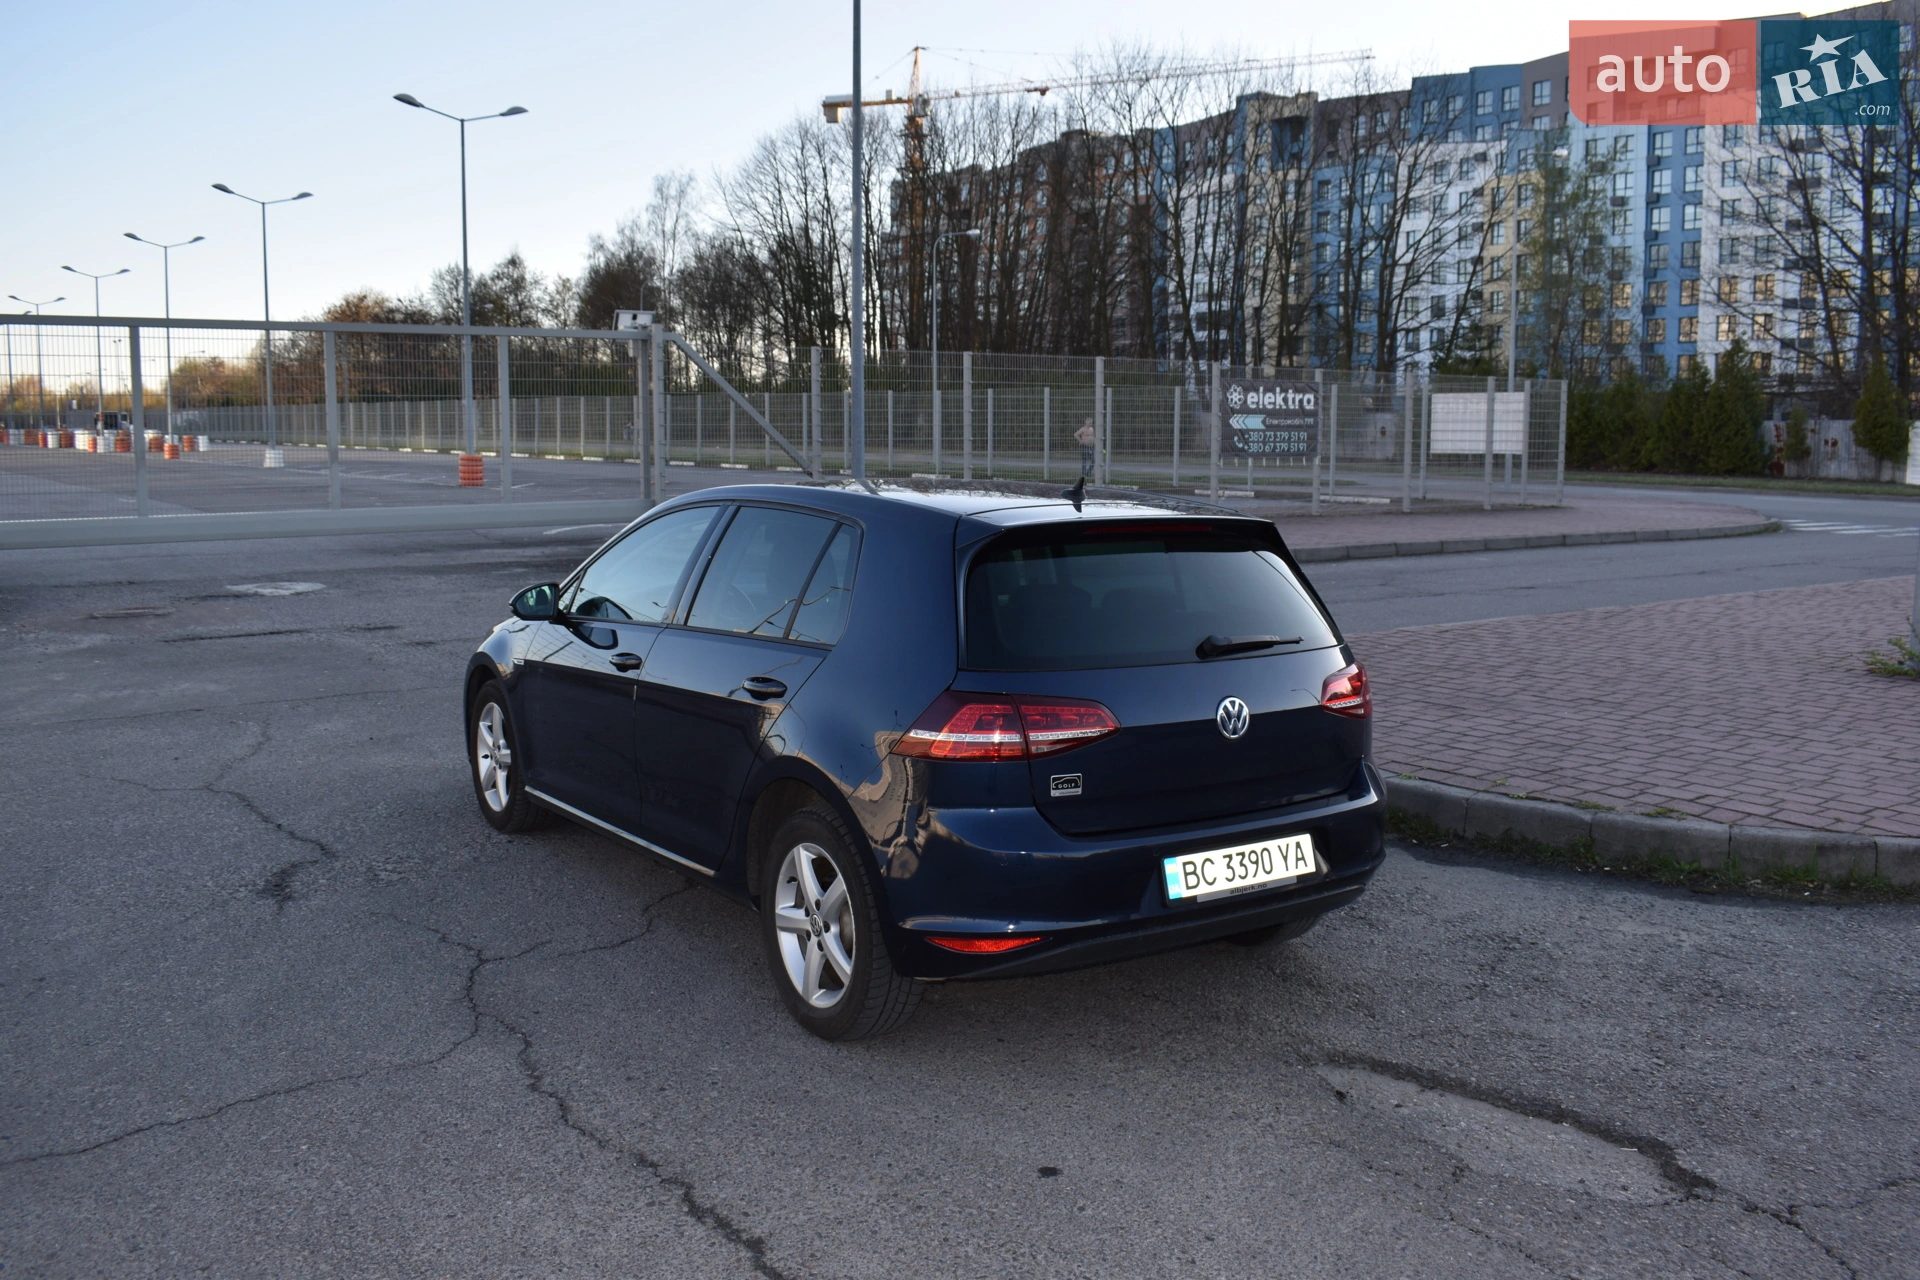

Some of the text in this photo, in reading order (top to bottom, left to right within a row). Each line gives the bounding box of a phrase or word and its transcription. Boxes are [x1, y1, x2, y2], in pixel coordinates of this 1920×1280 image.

[1247, 386, 1314, 409] elektra
[1244, 431, 1307, 441] +380 73 379 51 91
[1244, 442, 1307, 452] +380 67 379 51 91
[1182, 841, 1308, 890] BC 3390 YA
[1229, 882, 1268, 895] albjerk.no
